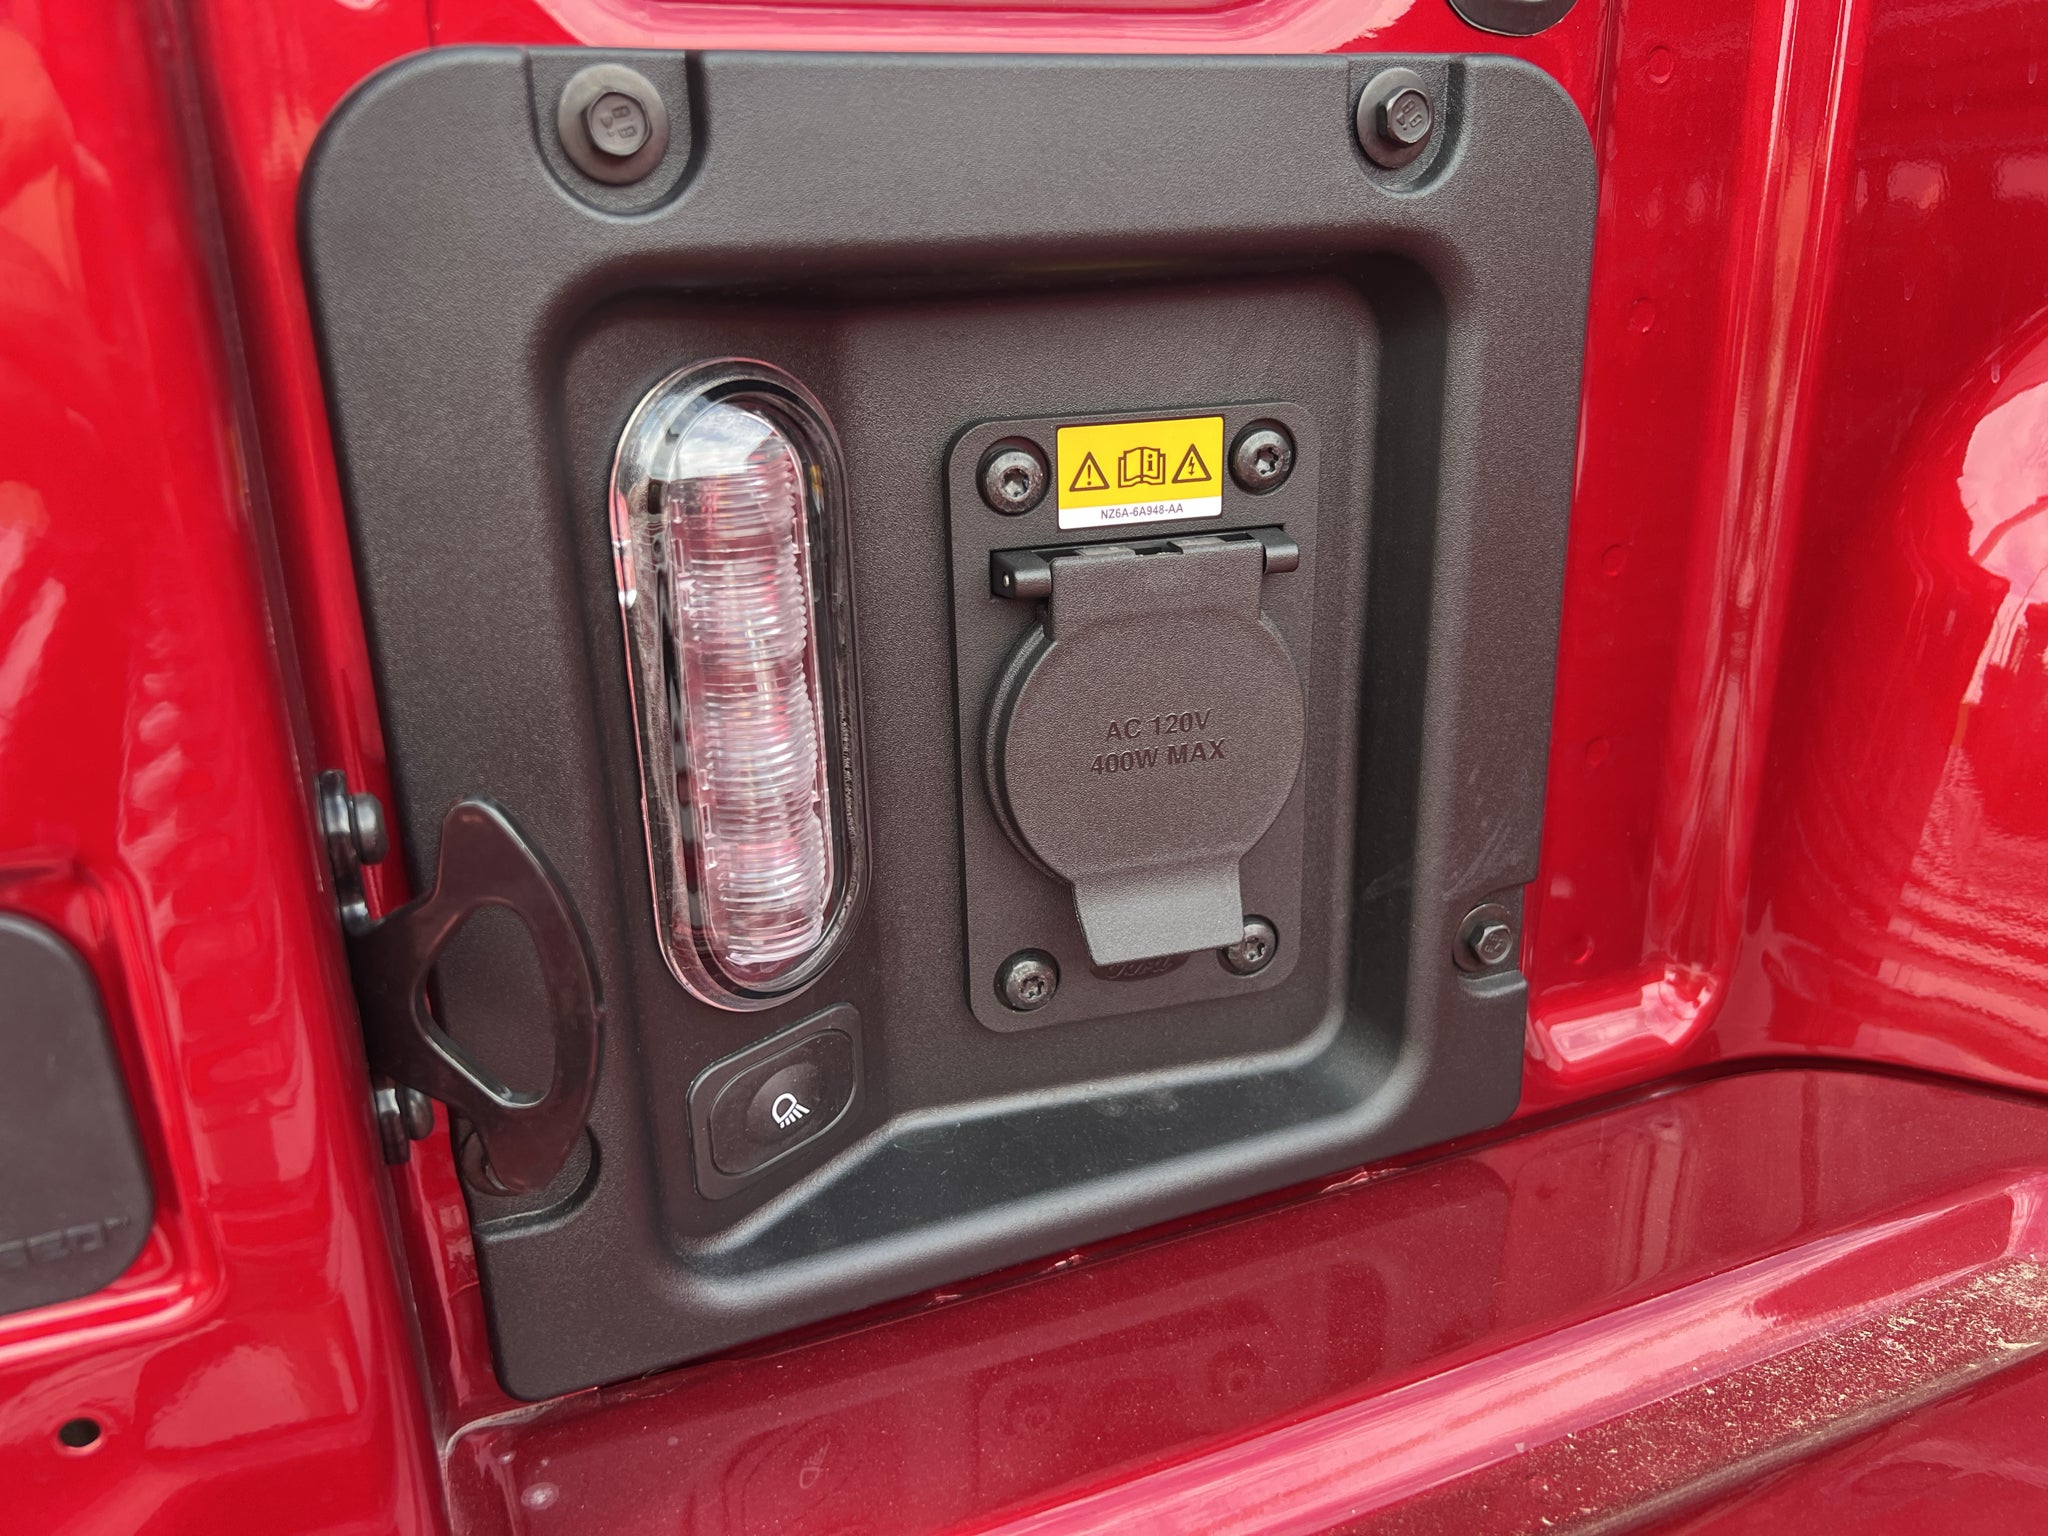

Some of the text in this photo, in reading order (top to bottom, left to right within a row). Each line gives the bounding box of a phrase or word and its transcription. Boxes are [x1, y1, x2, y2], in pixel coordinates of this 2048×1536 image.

[1100, 503, 1184, 520] NZ6A-6A948-AA
[1105, 708, 1215, 741] AC 120V
[1090, 737, 1226, 775] 400W MAX
